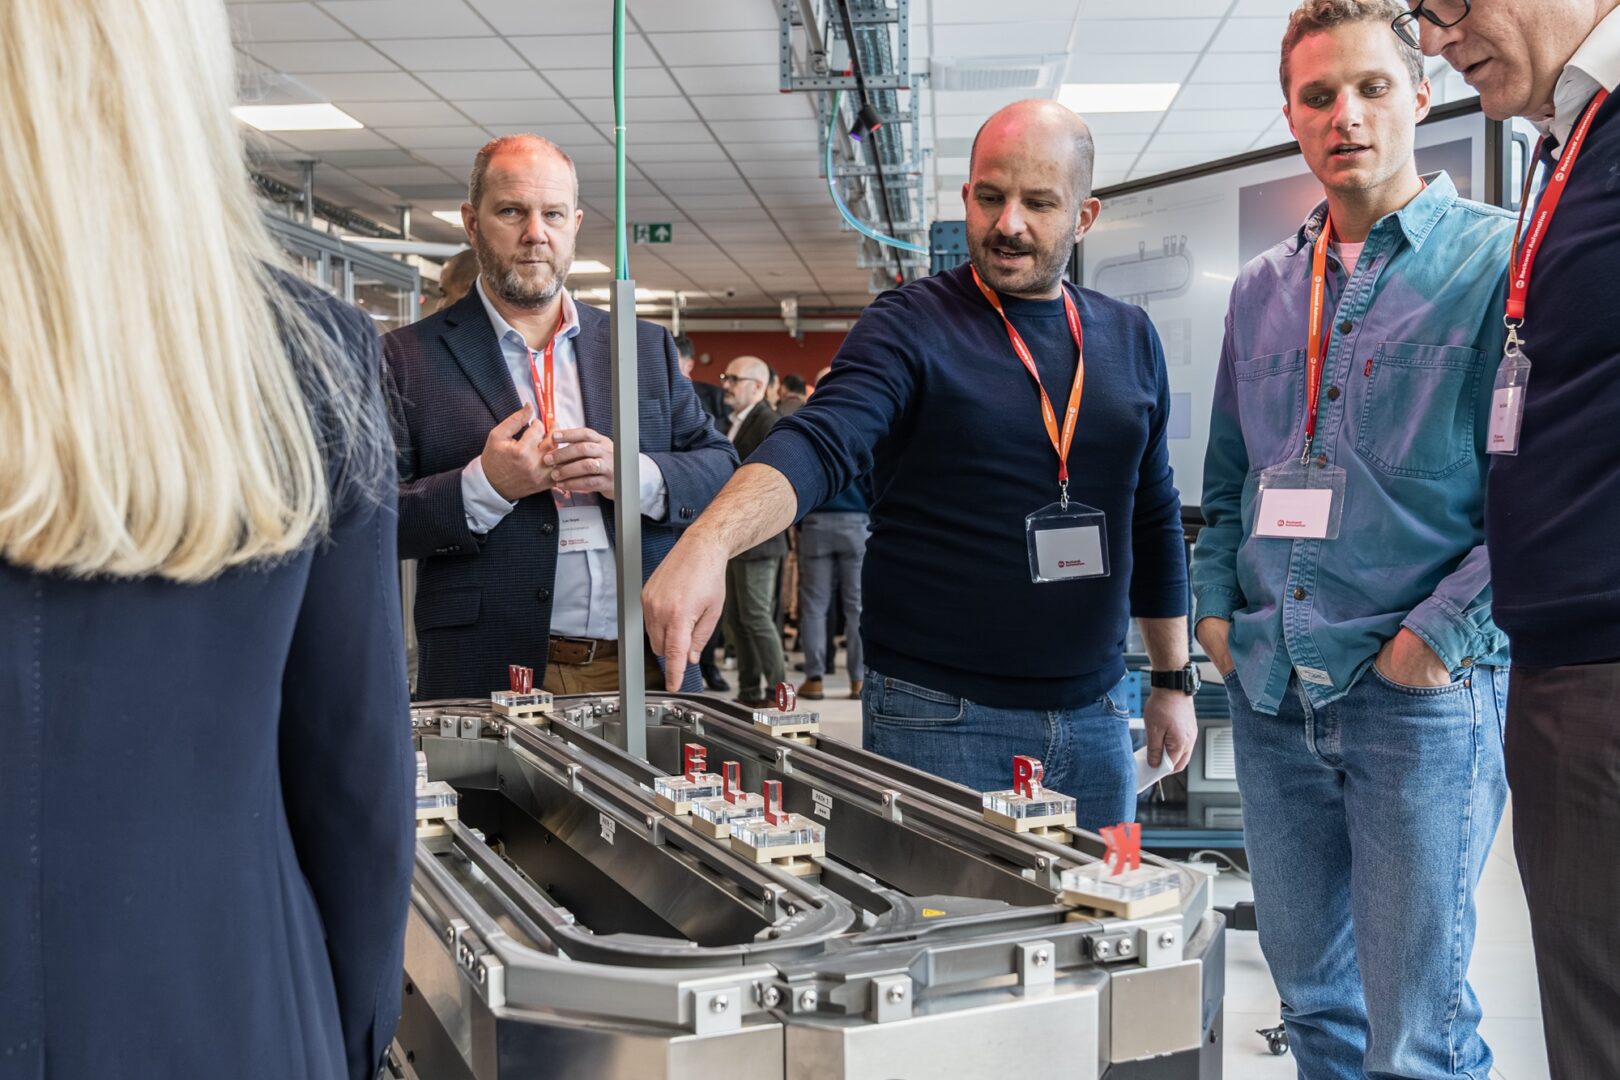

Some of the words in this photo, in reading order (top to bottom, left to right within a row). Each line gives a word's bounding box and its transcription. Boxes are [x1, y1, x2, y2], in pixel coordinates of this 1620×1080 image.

[1560, 139, 1578, 172] Rockwell
[1574, 102, 1599, 140] Automation
[1519, 248, 1533, 279] Rockwell
[1528, 210, 1548, 249] Automation
[684, 743, 707, 784] E
[722, 761, 747, 805] L
[1012, 755, 1043, 800] R
[763, 779, 789, 827] L
